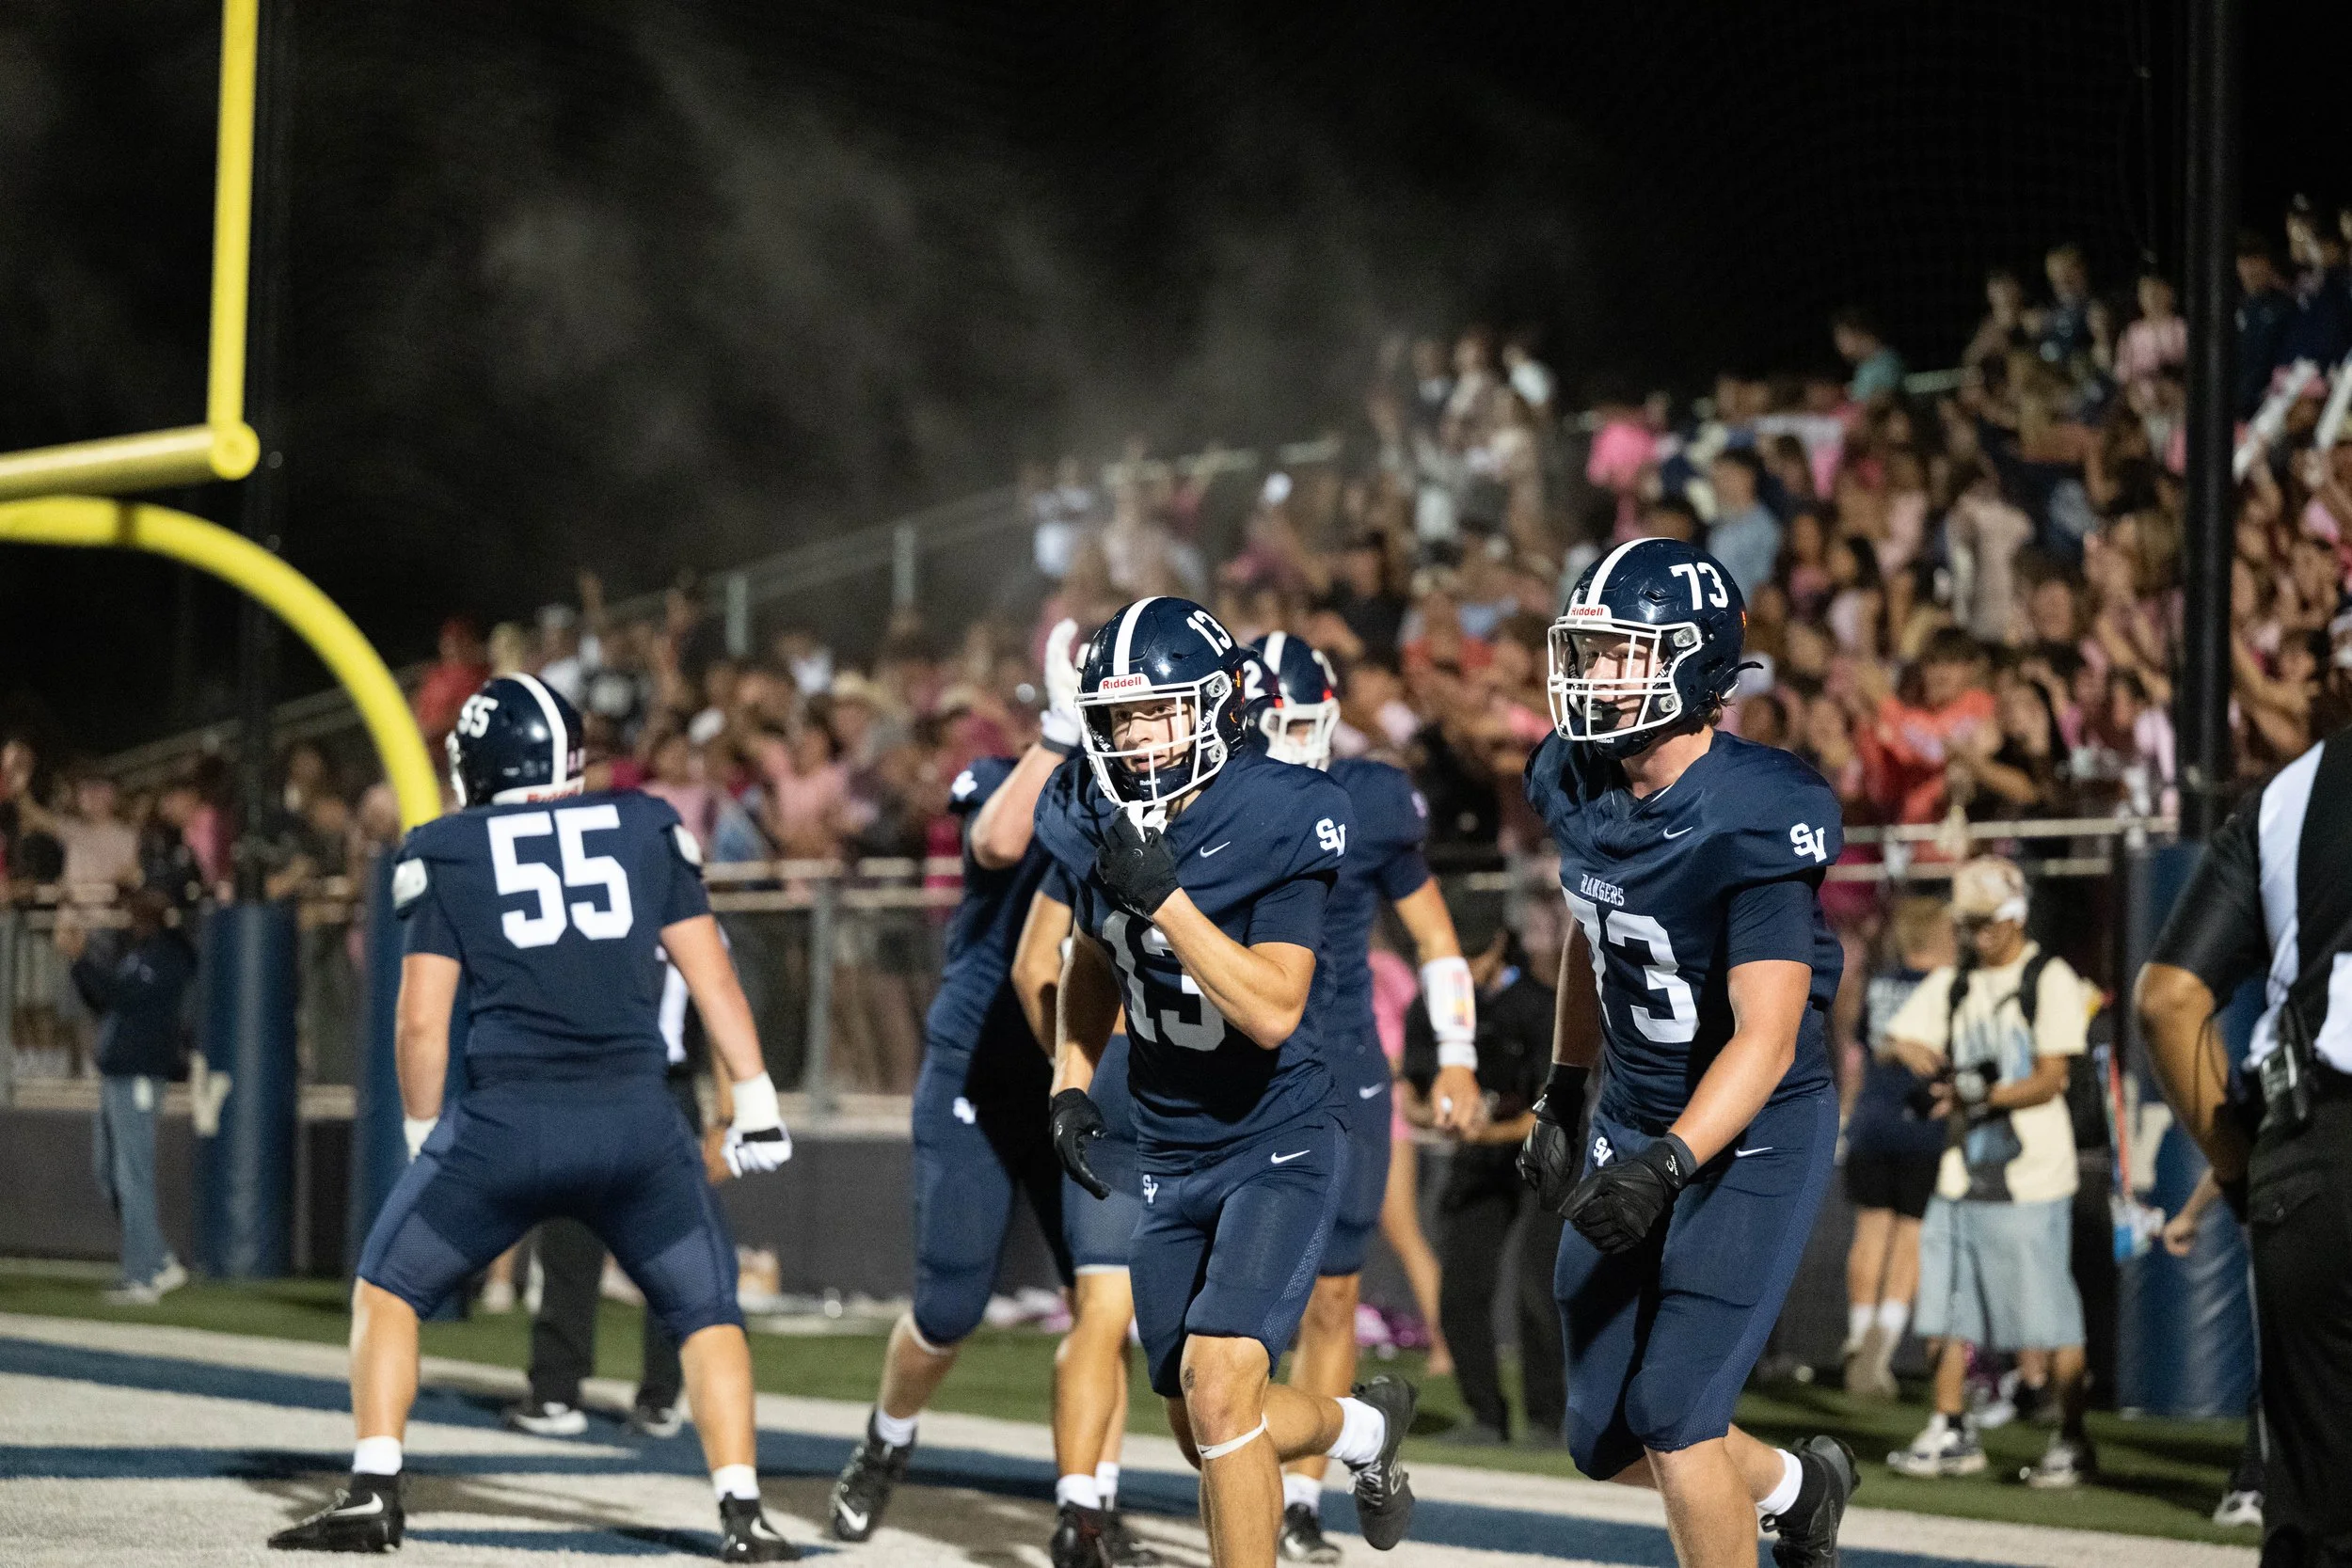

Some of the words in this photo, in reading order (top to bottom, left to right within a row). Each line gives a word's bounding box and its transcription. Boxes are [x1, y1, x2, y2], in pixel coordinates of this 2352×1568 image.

[1669, 562, 1729, 610] 73
[1571, 607, 1603, 616] Riddell
[1186, 610, 1232, 657] 13
[1103, 676, 1142, 689] Riddell
[457, 694, 499, 738] 55
[1315, 817, 1346, 857] SV
[1789, 822, 1827, 863] SV
[487, 804, 633, 948] 55
[1580, 873, 1625, 907] RANGERS
[1562, 885, 1700, 1043] 73
